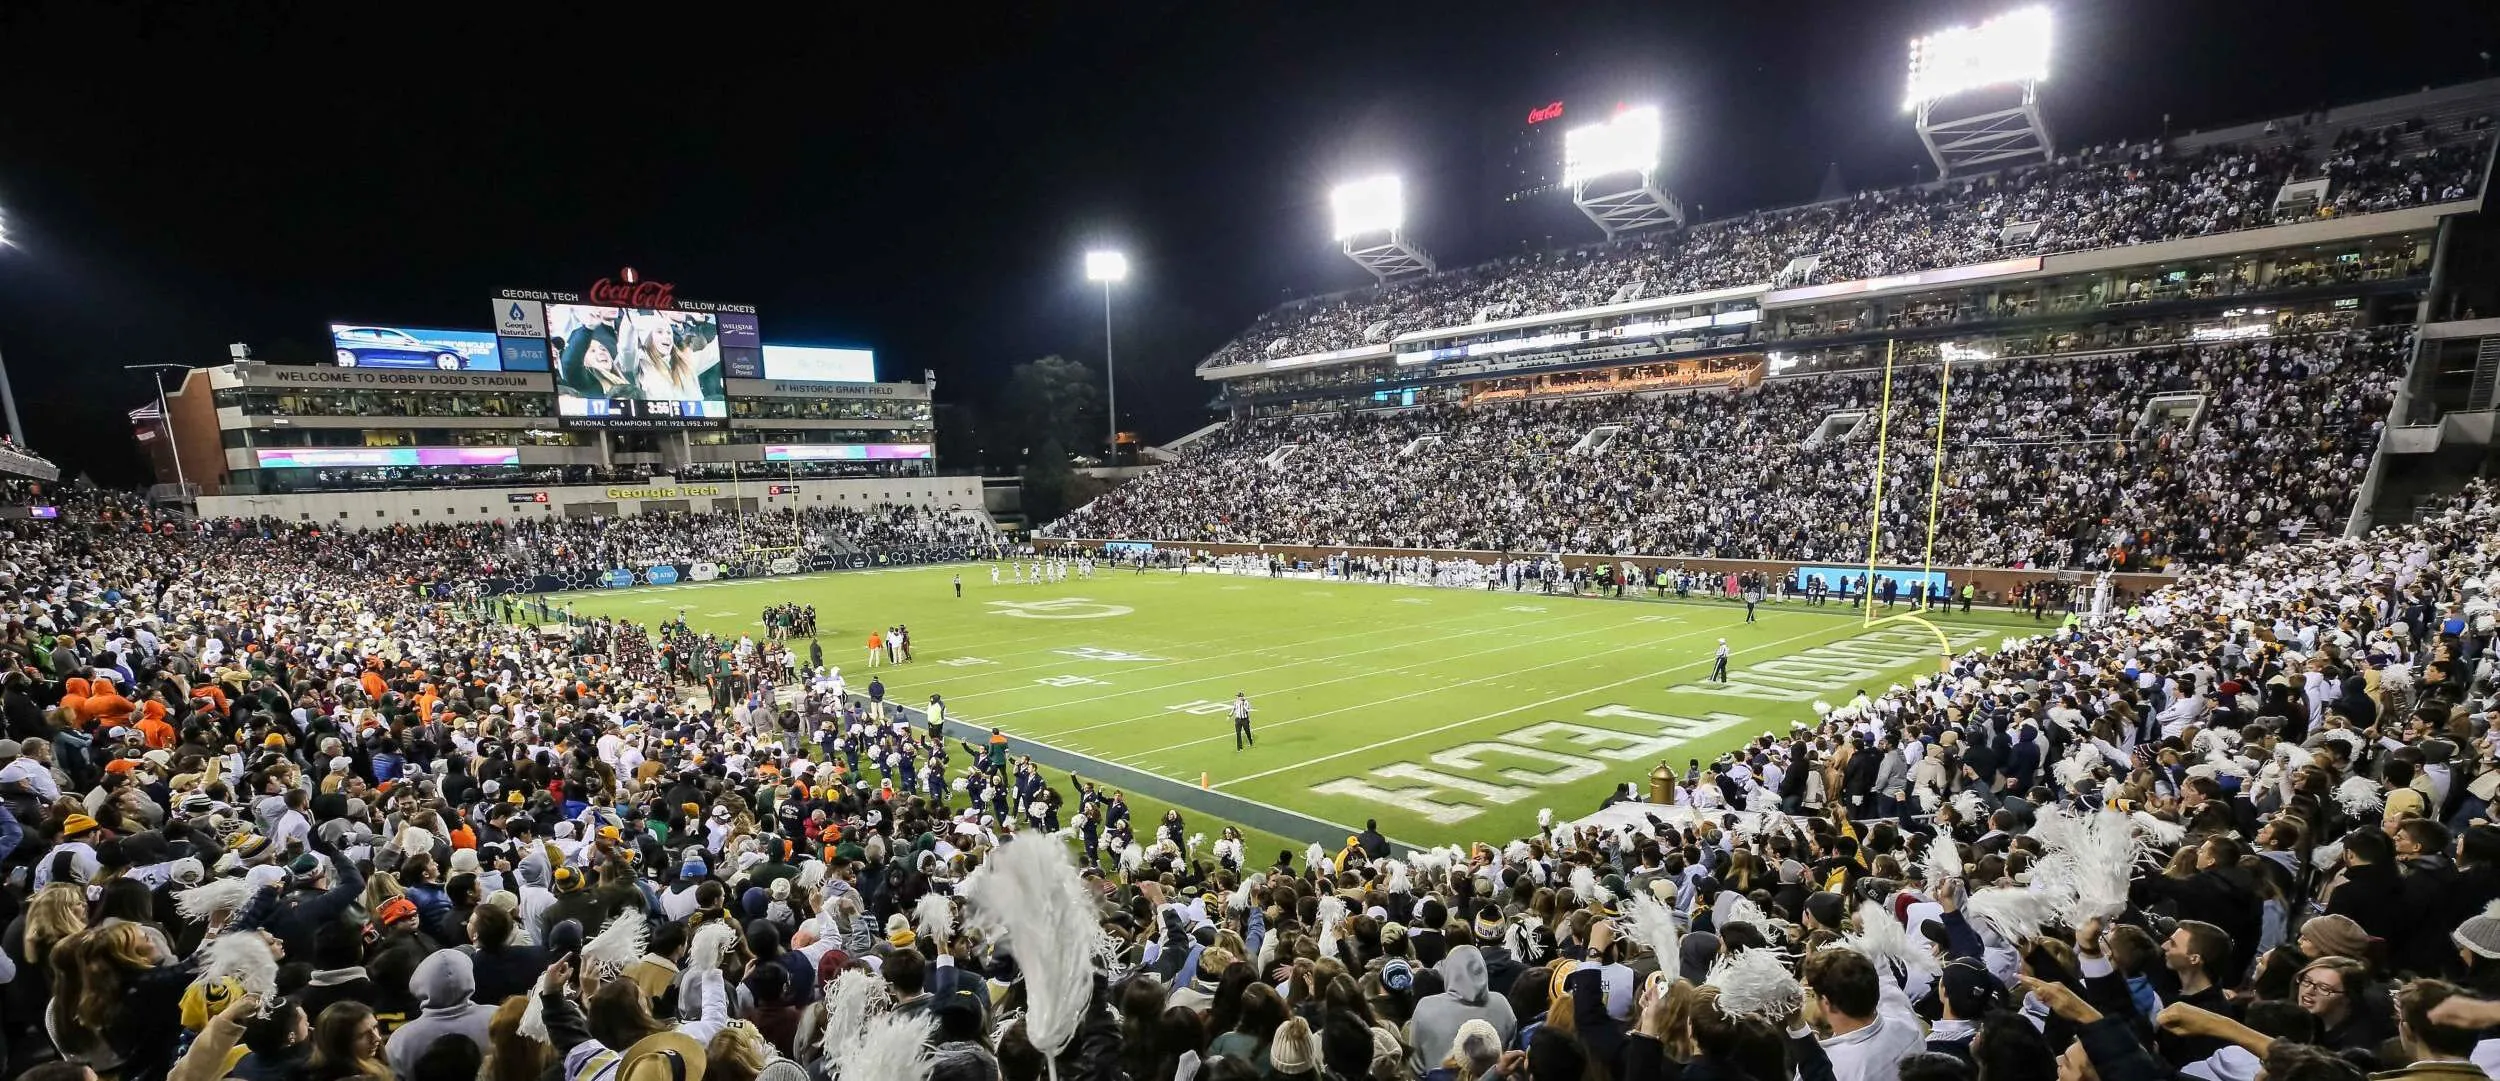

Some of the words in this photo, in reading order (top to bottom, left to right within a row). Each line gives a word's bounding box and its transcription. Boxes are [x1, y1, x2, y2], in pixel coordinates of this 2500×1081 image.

[502, 289, 549, 300] GEORGIA
[551, 292, 579, 302] TECH
[590, 277, 674, 309] Coca-Cola
[678, 301, 715, 312] YELLOW
[717, 304, 756, 314] JACKETS
[505, 321, 532, 330] Georgia
[520, 350, 544, 359] AT&T
[277, 371, 350, 382] WELCOME
[357, 373, 375, 383] TO
[380, 374, 424, 384] BOBBY
[430, 375, 467, 385] DODD
[472, 376, 527, 386] STADIUM
[775, 384, 786, 392] AT
[790, 384, 833, 393] HISTORIC
[836, 387, 865, 395] GRANT
[869, 387, 893, 395] FIELD
[592, 400, 605, 416] 17
[687, 401, 696, 415] 7
[609, 420, 652, 428] CHAMPIONS
[607, 488, 676, 499] Georgia
[682, 484, 720, 496] Tech
[1308, 702, 1752, 825] TECH
